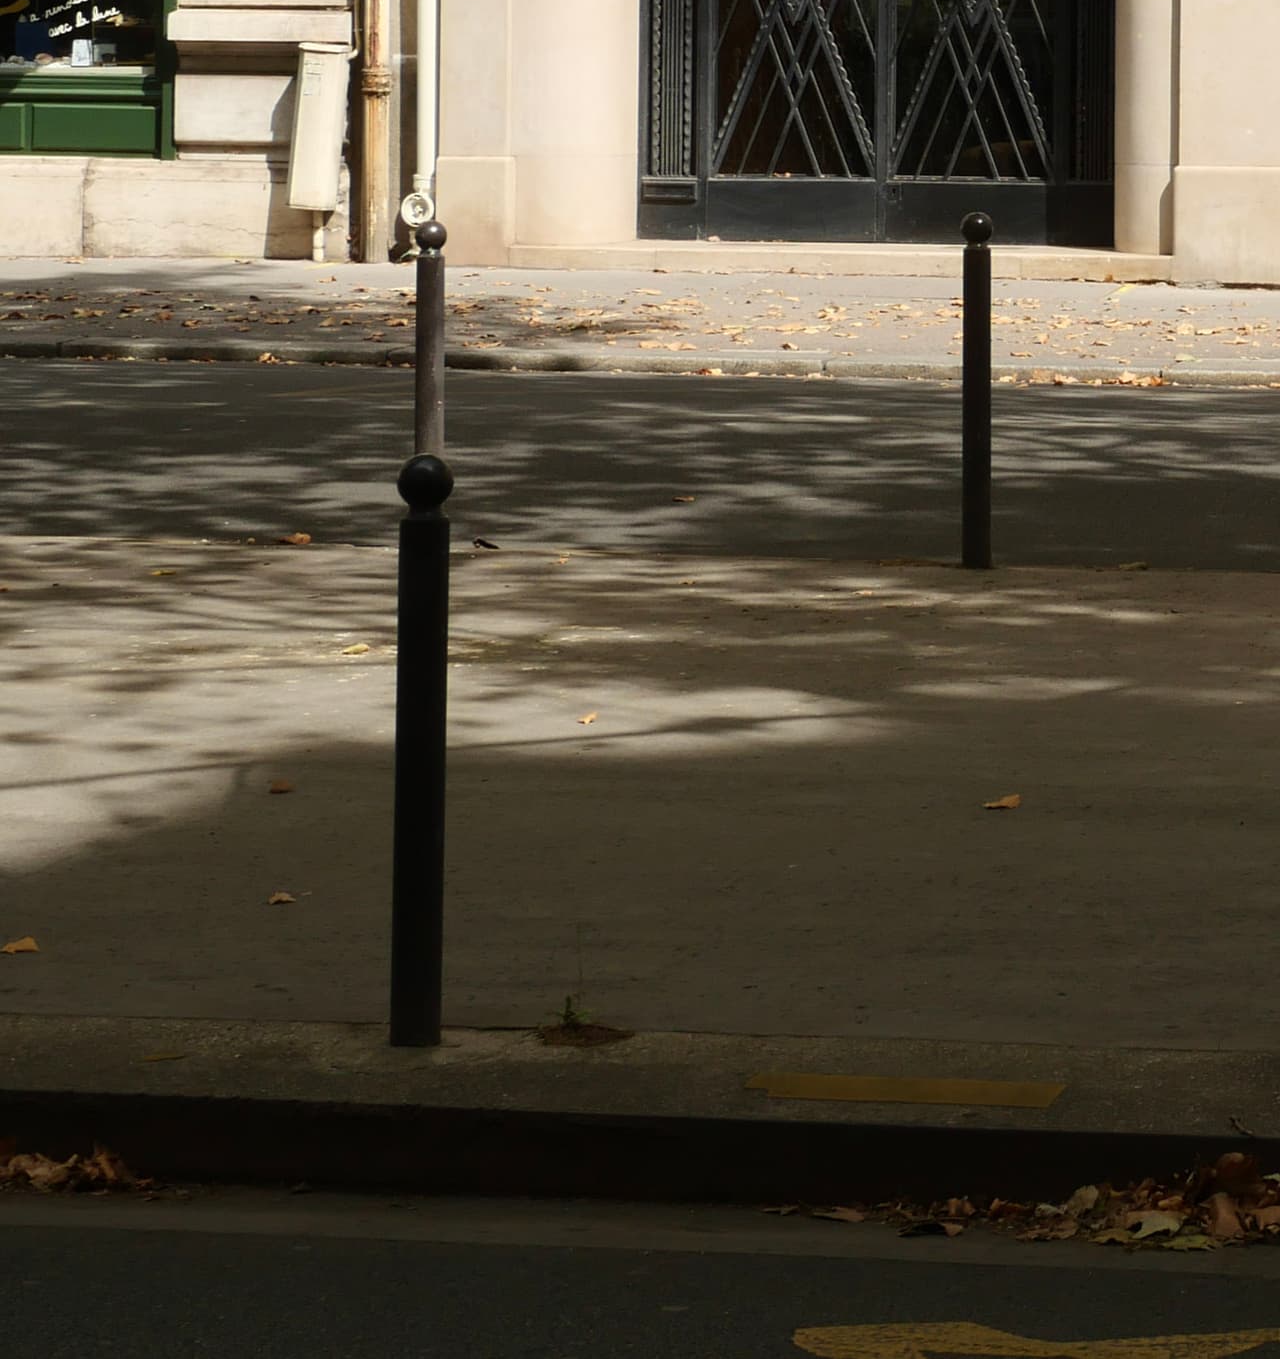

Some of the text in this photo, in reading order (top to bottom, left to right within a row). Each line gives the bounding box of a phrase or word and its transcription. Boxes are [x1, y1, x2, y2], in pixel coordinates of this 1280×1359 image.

[48, 5, 120, 38] avec la lune
